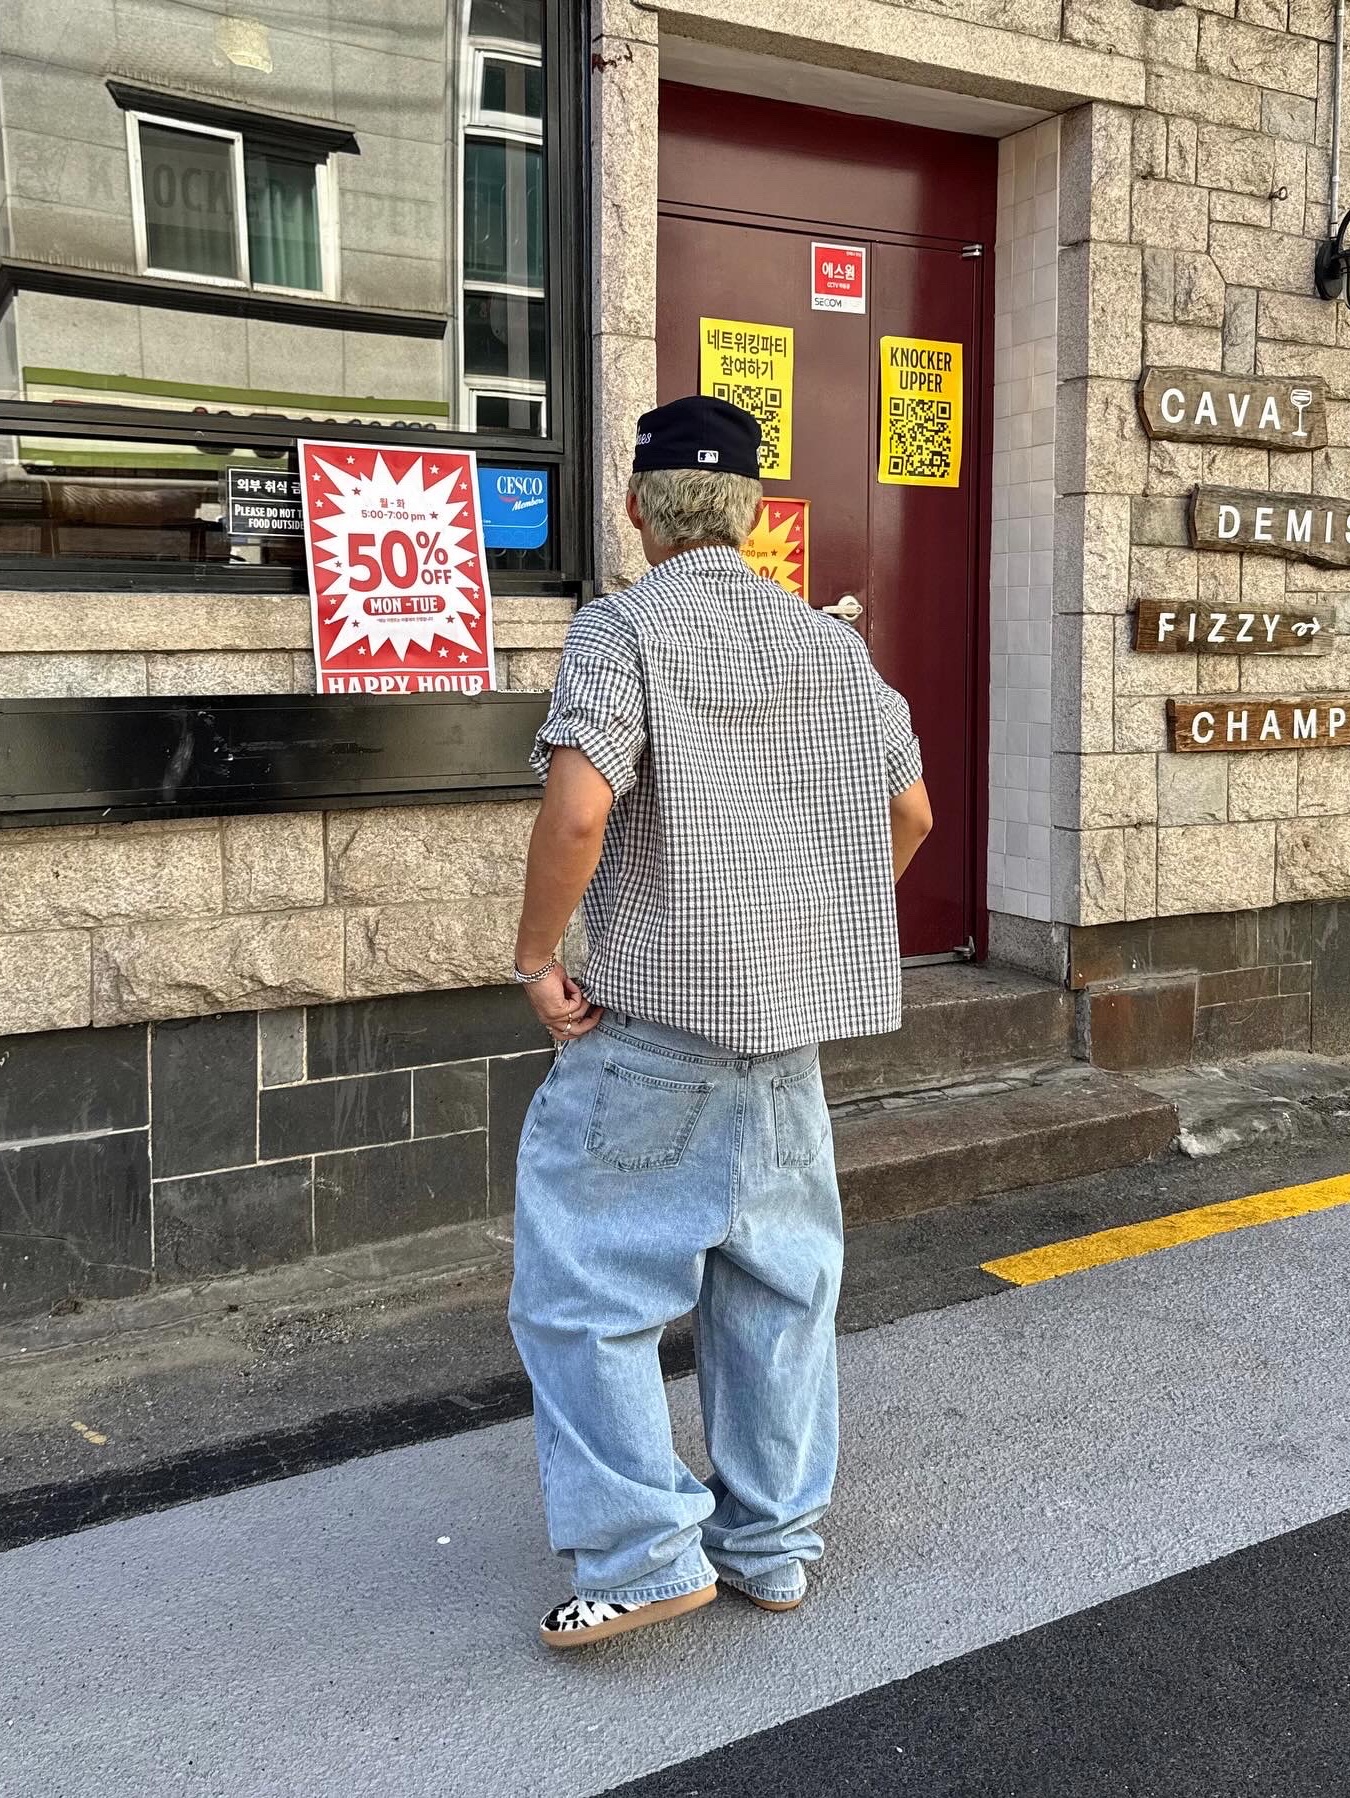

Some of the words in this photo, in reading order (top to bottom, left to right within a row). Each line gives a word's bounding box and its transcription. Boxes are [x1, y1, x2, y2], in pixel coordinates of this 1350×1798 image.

[822, 261, 855, 281] 에스원
[814, 297, 842, 308] SECOM
[707, 329, 787, 358] 네트워킹파티
[720, 355, 774, 381] 참여하기
[890, 346, 952, 372] KNOCKER
[900, 370, 943, 393] UPPER
[1160, 388, 1282, 430] CAVA
[237, 479, 262, 492] 외부
[264, 480, 288, 494] 취식
[496, 475, 543, 496] CESCO
[234, 504, 266, 517] PLEASE
[266, 507, 278, 518] DO
[279, 508, 296, 519] NOT
[361, 509, 409, 520] 5:00-7:00
[411, 514, 426, 523] pm
[248, 518, 271, 529] FOOD
[1217, 504, 1350, 544] DEMI
[347, 529, 449, 593] 50%
[420, 568, 452, 585] OFF
[370, 597, 402, 614] MON
[1158, 612, 1280, 643] FIZZY
[327, 676, 411, 694] HAPPY
[417, 674, 484, 696] HOUR
